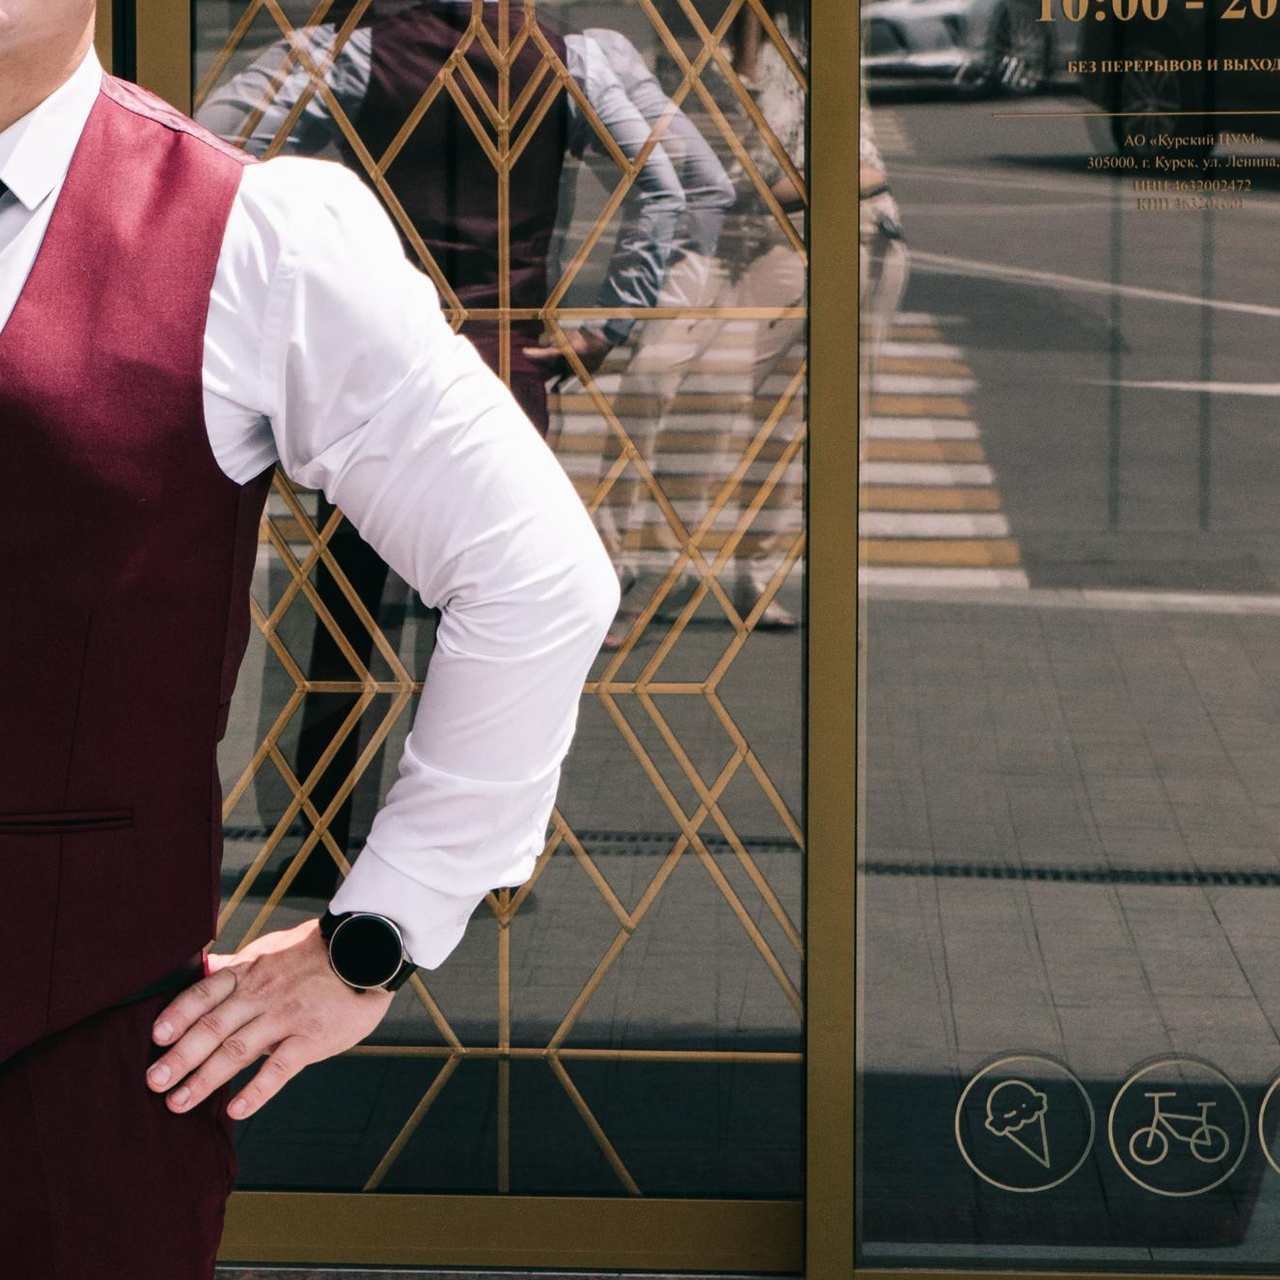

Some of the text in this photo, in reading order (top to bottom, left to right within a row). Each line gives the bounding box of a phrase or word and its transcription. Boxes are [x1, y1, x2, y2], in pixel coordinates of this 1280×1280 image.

[1185, 1, 1204, 9] -
[1068, 60, 1097, 73] БЕЗ
[1101, 59, 1202, 72] ПЕРЕРЫВОВ
[1207, 59, 1218, 71] И
[1124, 132, 1263, 149] АО «Курский ЦУМ»
[1087, 156, 1138, 169] 305000,
[1142, 159, 1151, 169] г.
[1202, 158, 1222, 171] ул.
[1173, 179, 1252, 192] 4632002472
